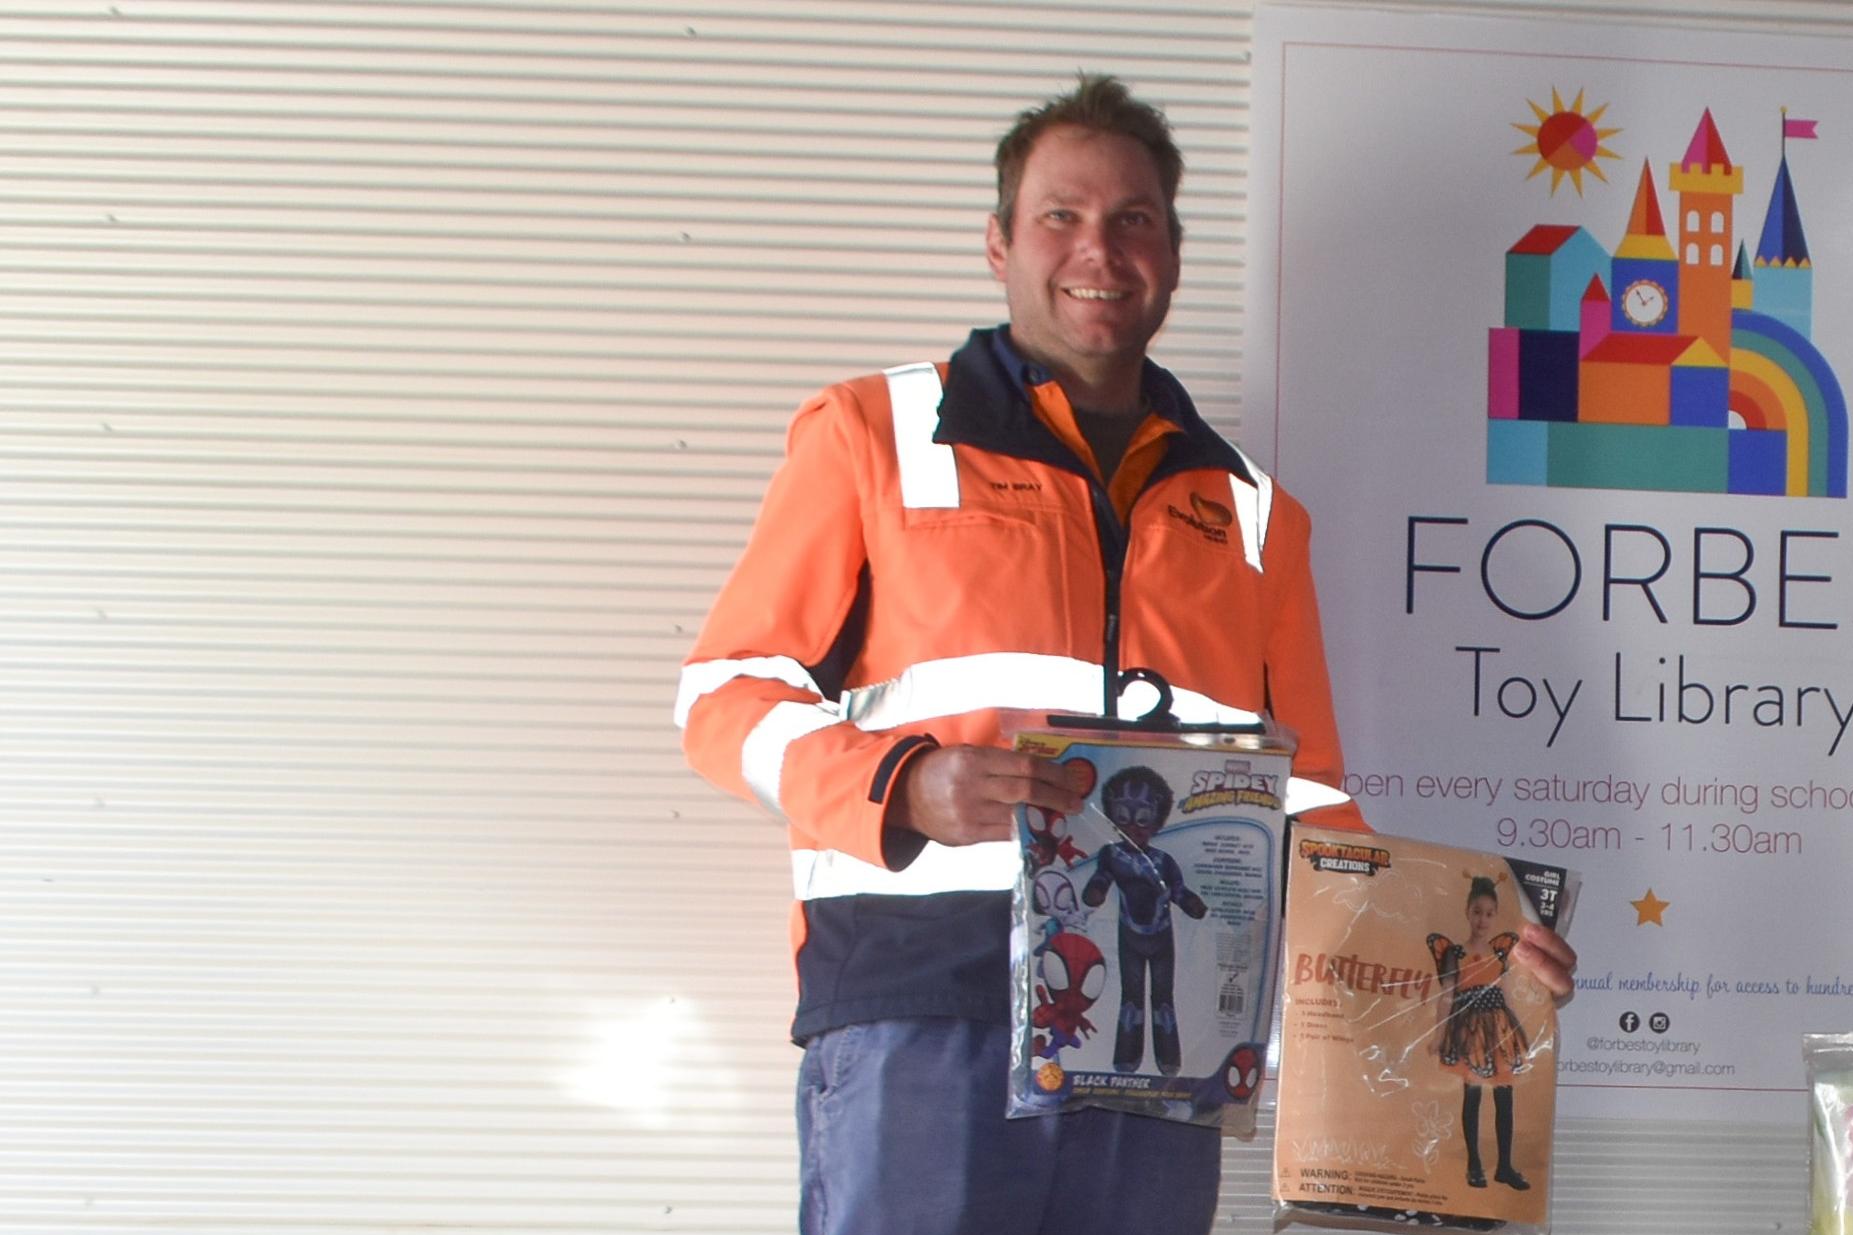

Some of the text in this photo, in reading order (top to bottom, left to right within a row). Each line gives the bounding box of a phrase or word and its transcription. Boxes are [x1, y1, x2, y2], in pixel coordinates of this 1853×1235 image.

[1455, 645, 1583, 748] Toy
[1192, 770, 1279, 796] SPIDEY
[1343, 773, 1404, 797] pen
[1416, 774, 1503, 806] every
[1513, 774, 1651, 810] saturday
[1661, 776, 1759, 814] during
[1497, 818, 1621, 850] 9.30am
[1661, 823, 1802, 854] 11.30am
[1299, 839, 1391, 868] SPOOKTACULAR
[1320, 857, 1371, 872] CREATIONS
[1524, 873, 1560, 887] COSTUME
[1540, 888, 1558, 902] 3T
[1294, 953, 1433, 1006] BUTTERFLY
[1618, 971, 1700, 1000] membership
[1706, 974, 1731, 998] for
[1736, 980, 1780, 995] access
[1786, 978, 1800, 995] to
[1072, 1074, 1151, 1089] BLACK PANTHER
[1557, 1059, 1735, 1077] orbestoylibrary@gmail.com
